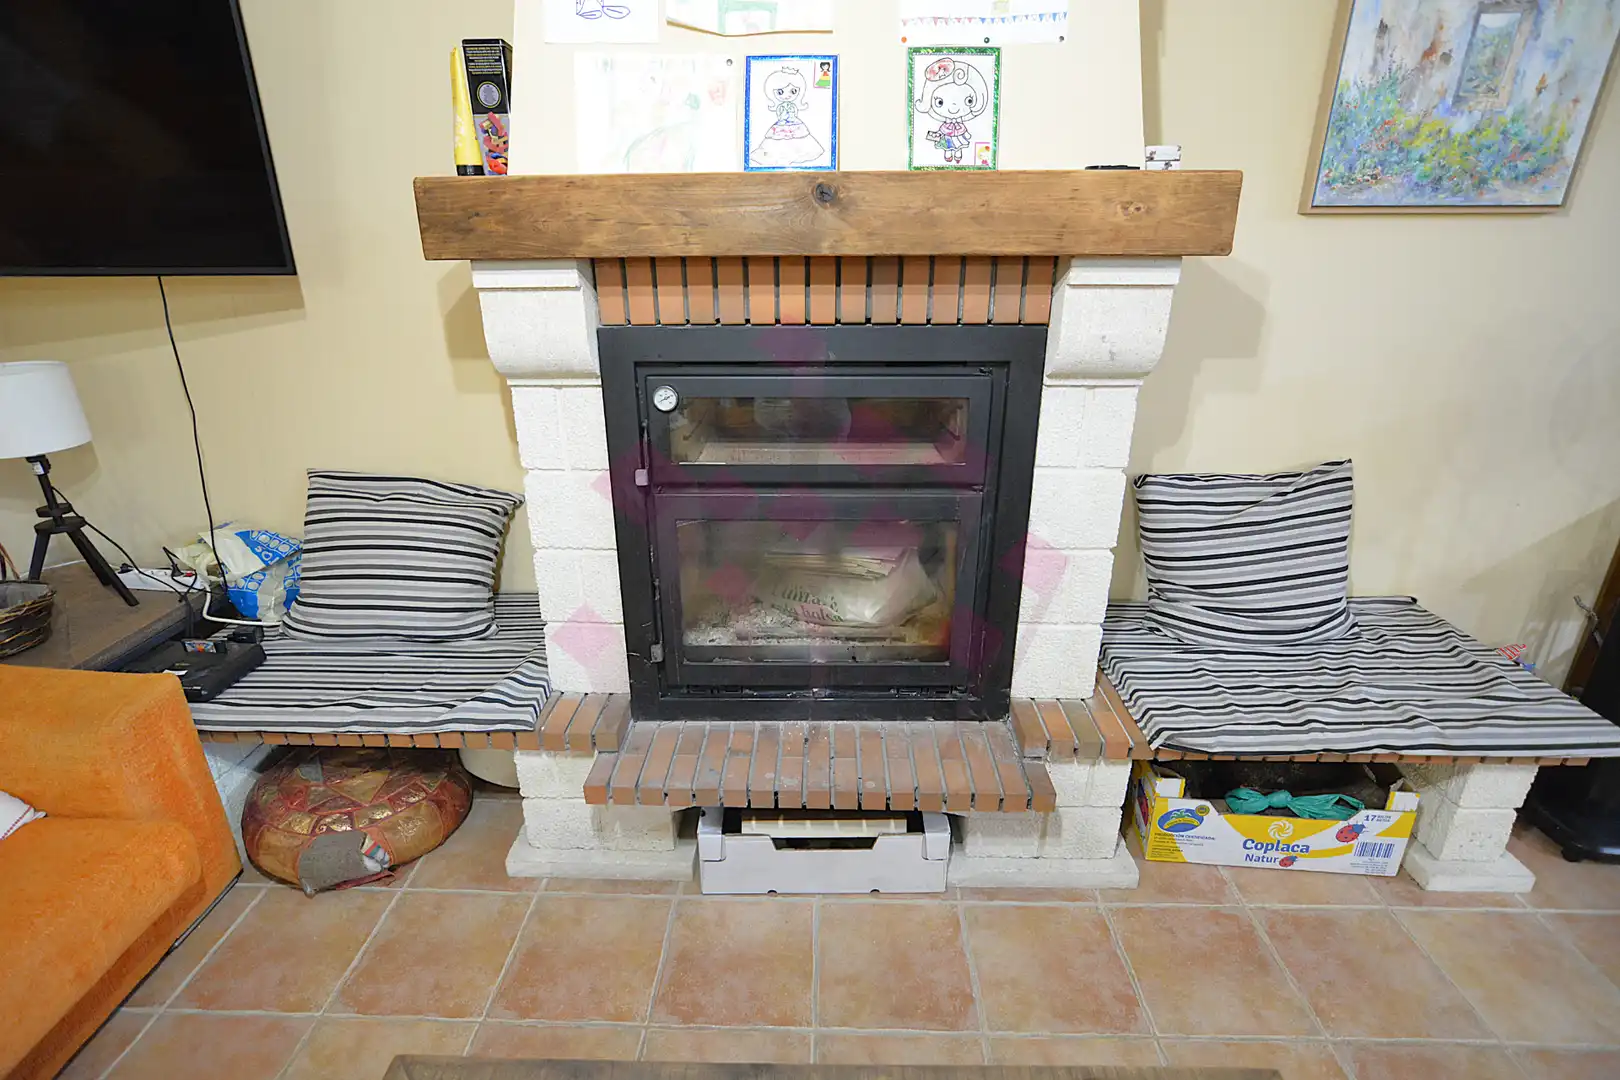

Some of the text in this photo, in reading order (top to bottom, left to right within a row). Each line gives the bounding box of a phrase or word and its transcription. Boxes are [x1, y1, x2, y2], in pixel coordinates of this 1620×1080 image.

[1363, 814, 1377, 822] 17
[1242, 838, 1311, 854] Coplaca
[1244, 853, 1280, 864] Natur
